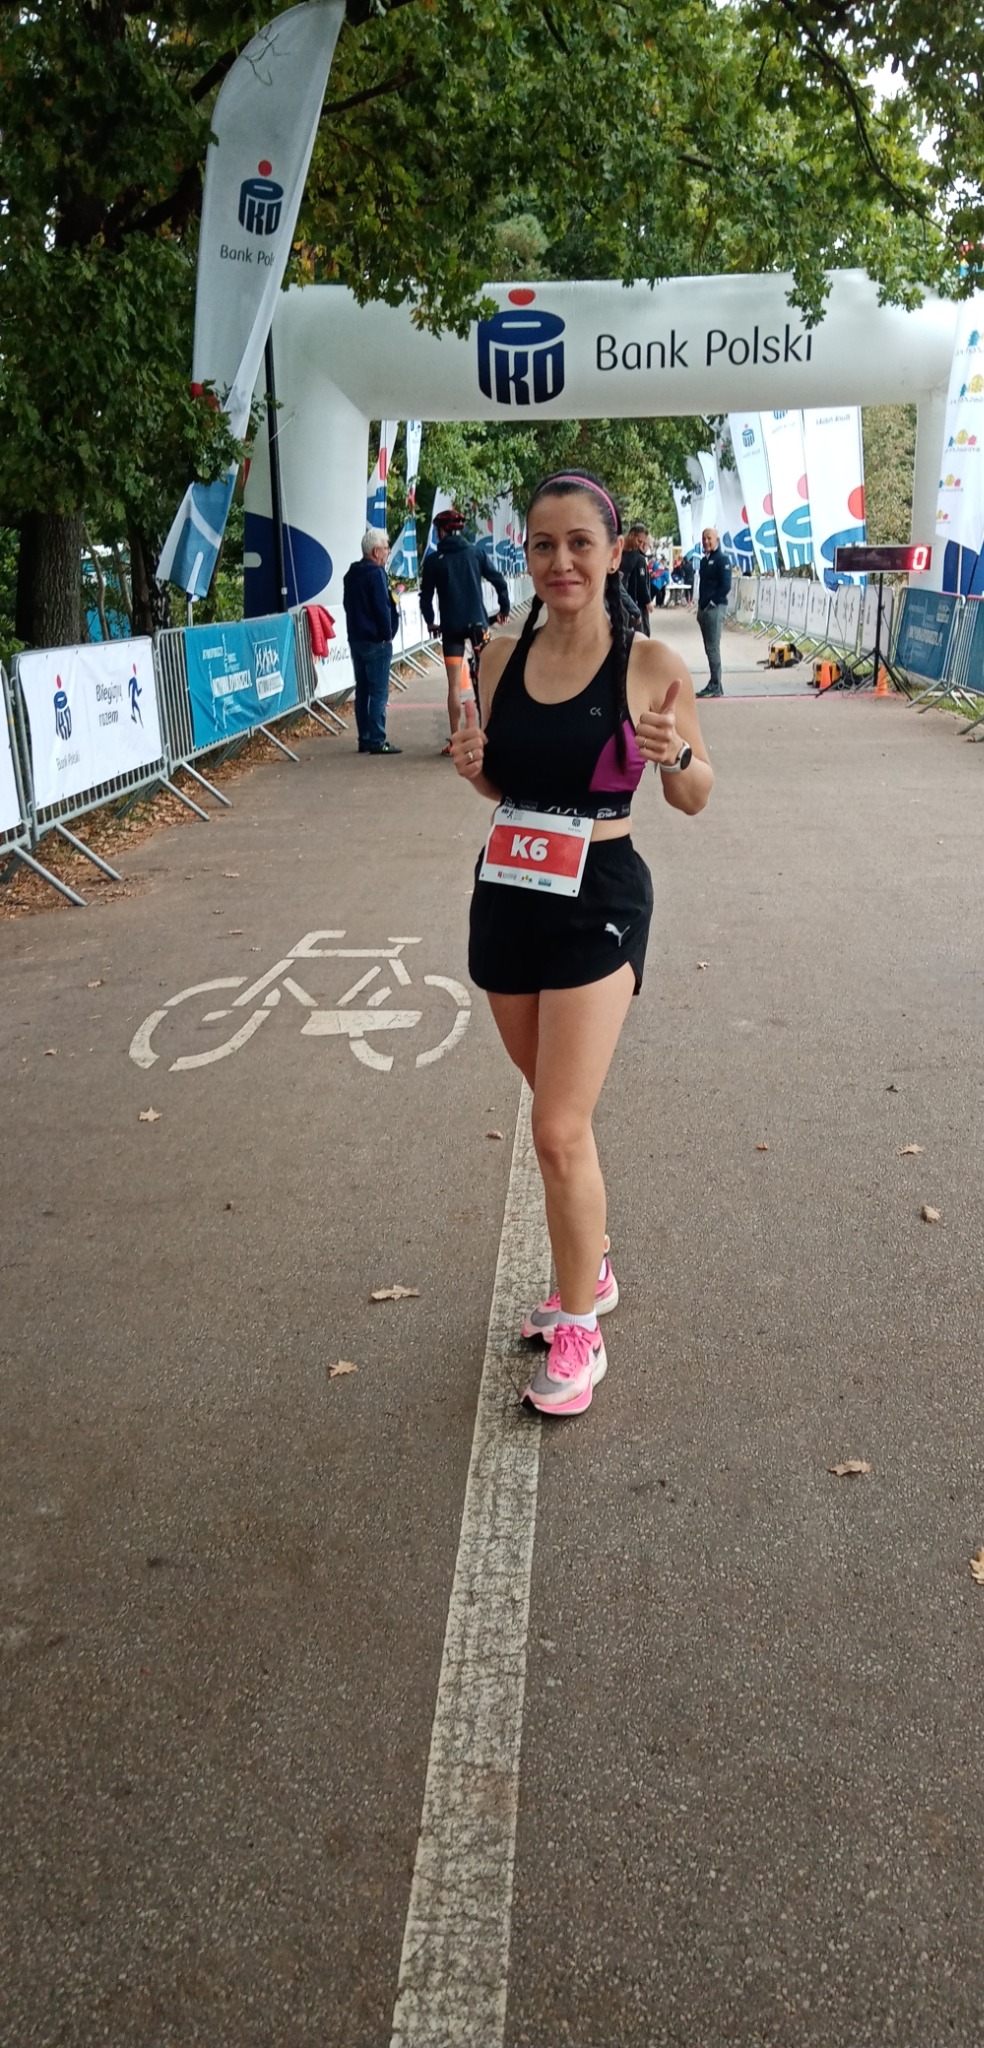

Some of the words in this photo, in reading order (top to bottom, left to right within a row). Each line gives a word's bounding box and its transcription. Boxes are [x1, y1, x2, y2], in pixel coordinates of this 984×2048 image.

[220, 244, 252, 264] Bank
[257, 249, 275, 267] Pol
[596, 329, 689, 372] Bank
[706, 324, 813, 367] Polski
[912, 546, 929, 571] 0
[99, 710, 119, 727] razem
[510, 834, 550, 862] K6
